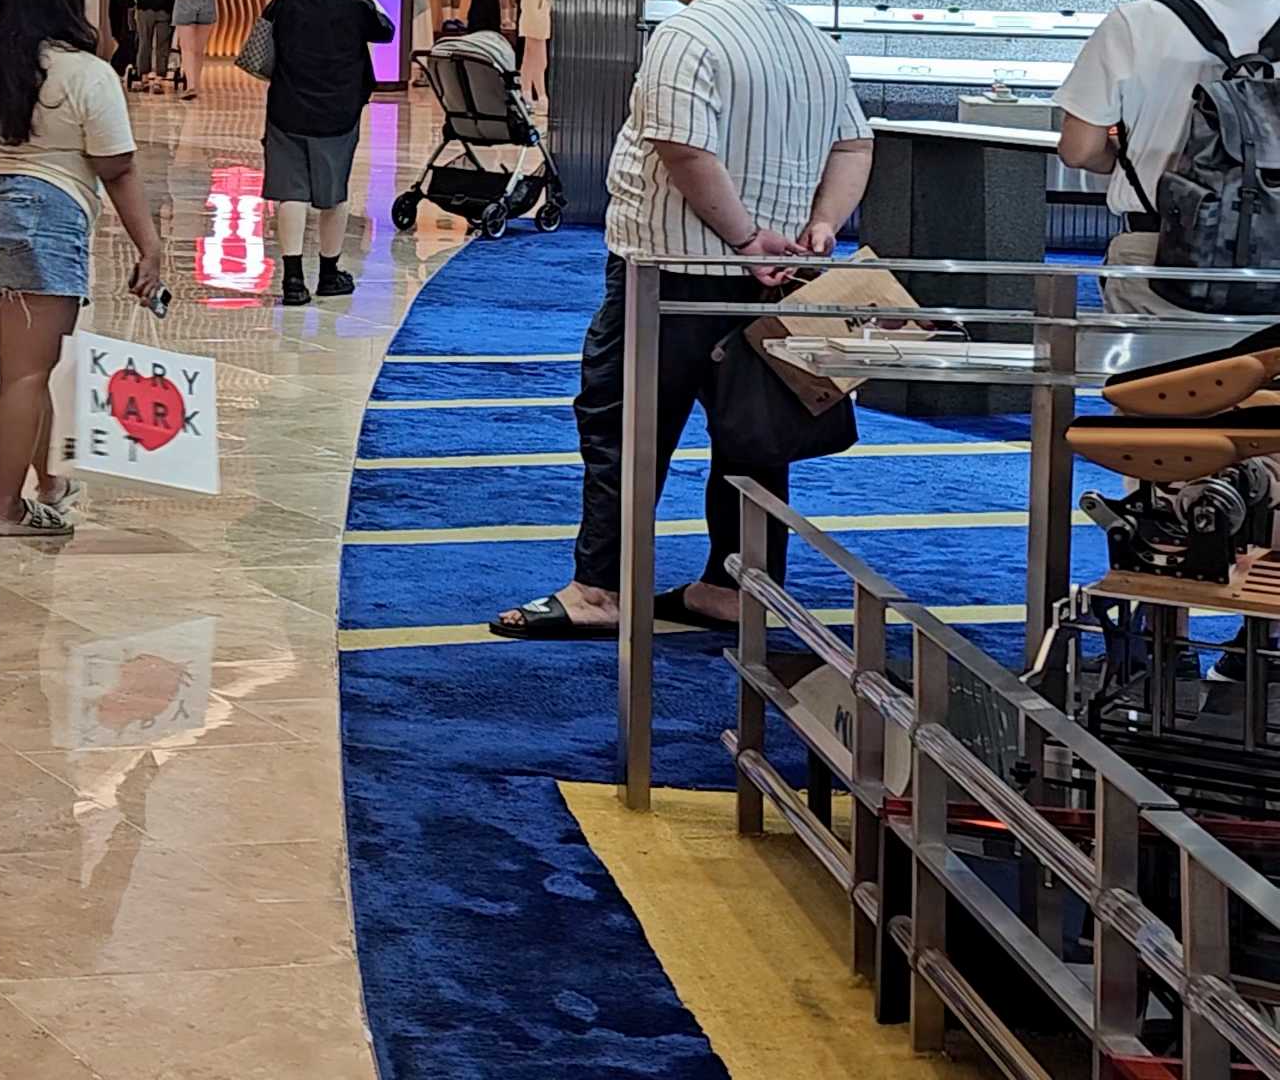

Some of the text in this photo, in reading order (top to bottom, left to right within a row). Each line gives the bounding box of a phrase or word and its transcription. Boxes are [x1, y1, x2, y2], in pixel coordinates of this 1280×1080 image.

[89, 348, 201, 396] KARY
[90, 388, 202, 437] MARK
[90, 428, 145, 463] ET
